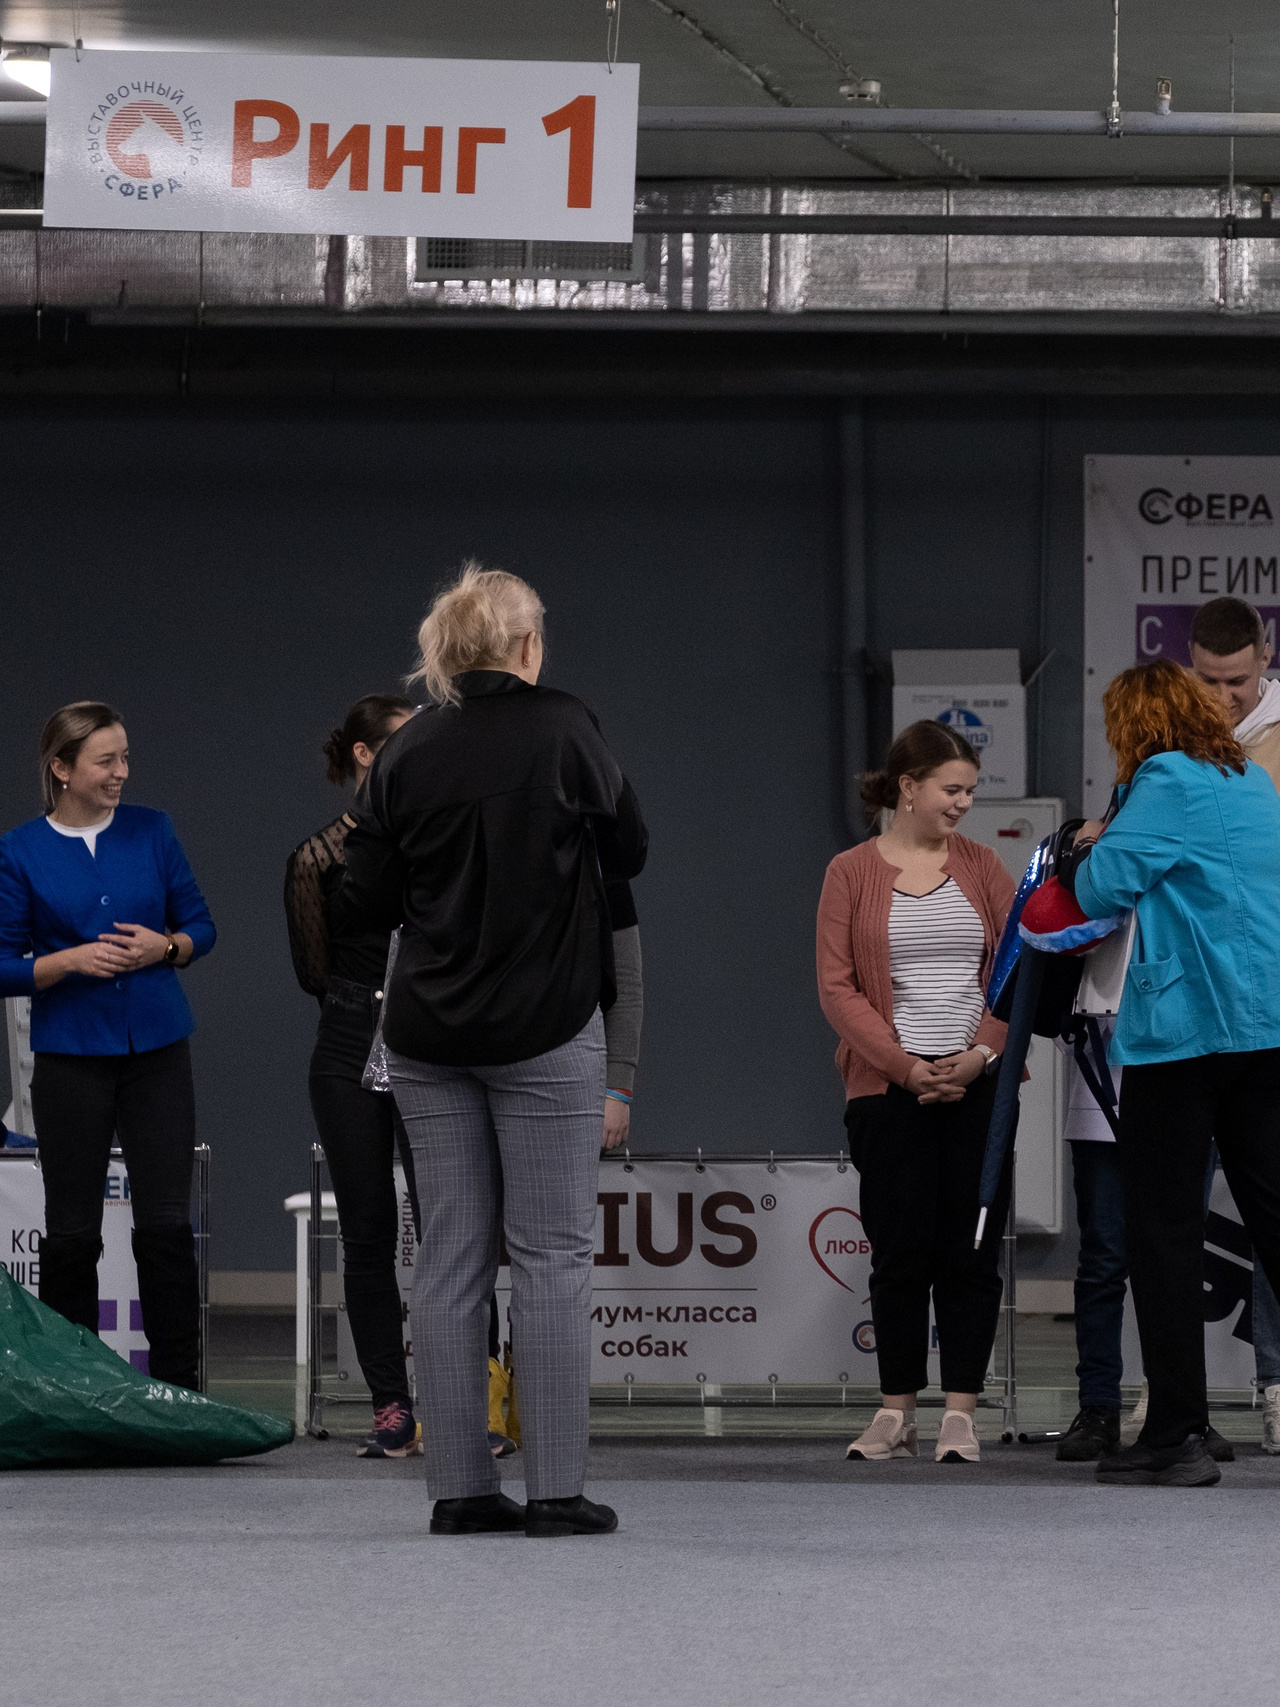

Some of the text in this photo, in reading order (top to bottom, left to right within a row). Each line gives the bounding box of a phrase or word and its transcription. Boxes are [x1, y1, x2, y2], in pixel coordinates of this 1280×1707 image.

[87, 80, 203, 166] ВЫСТАВОЧНЫЙ ЦЕНТР
[230, 94, 597, 209] Ринг 1
[104, 174, 183, 200] СФЕРА
[1138, 486, 1274, 525] СФЕРА
[1139, 615, 1164, 656] С
[591, 1304, 757, 1328] иум-класса
[601, 1334, 689, 1357] собак
